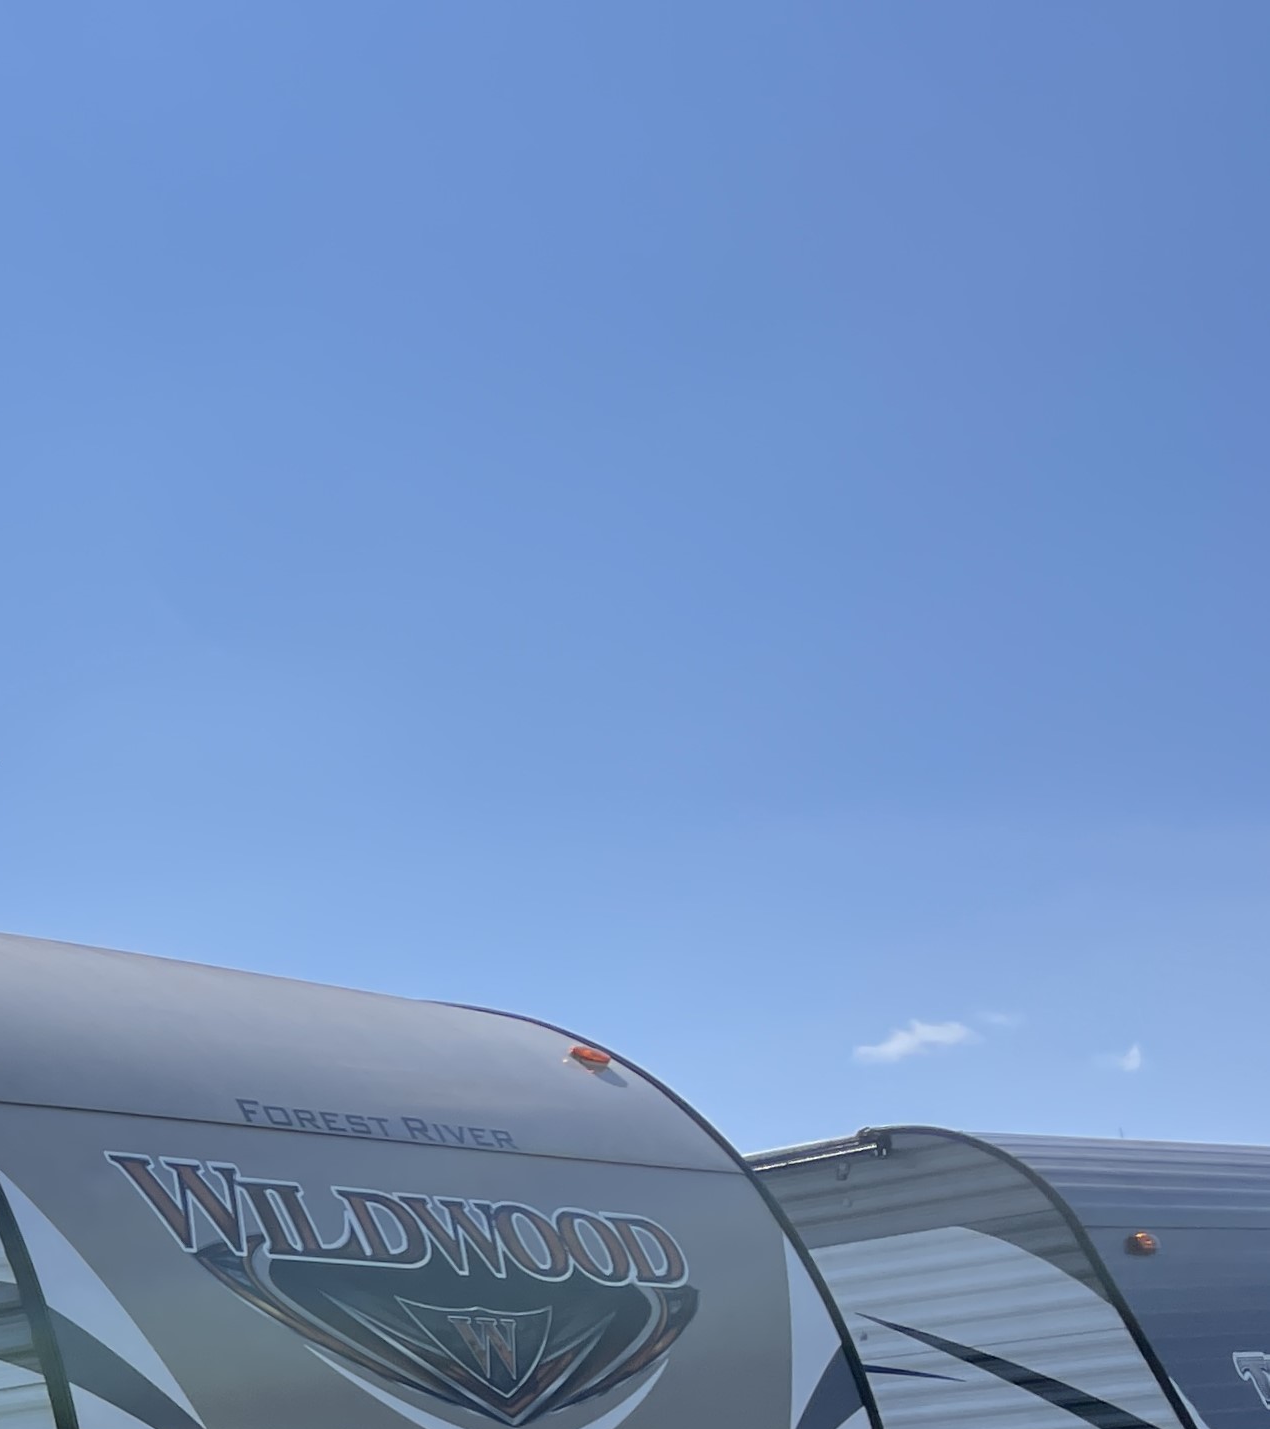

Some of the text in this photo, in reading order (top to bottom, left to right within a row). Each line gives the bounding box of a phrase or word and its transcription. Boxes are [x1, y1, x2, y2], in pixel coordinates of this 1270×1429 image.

[235, 1098, 519, 1150] FOREST RIVER
[103, 1149, 690, 1288] WILDWOOD
